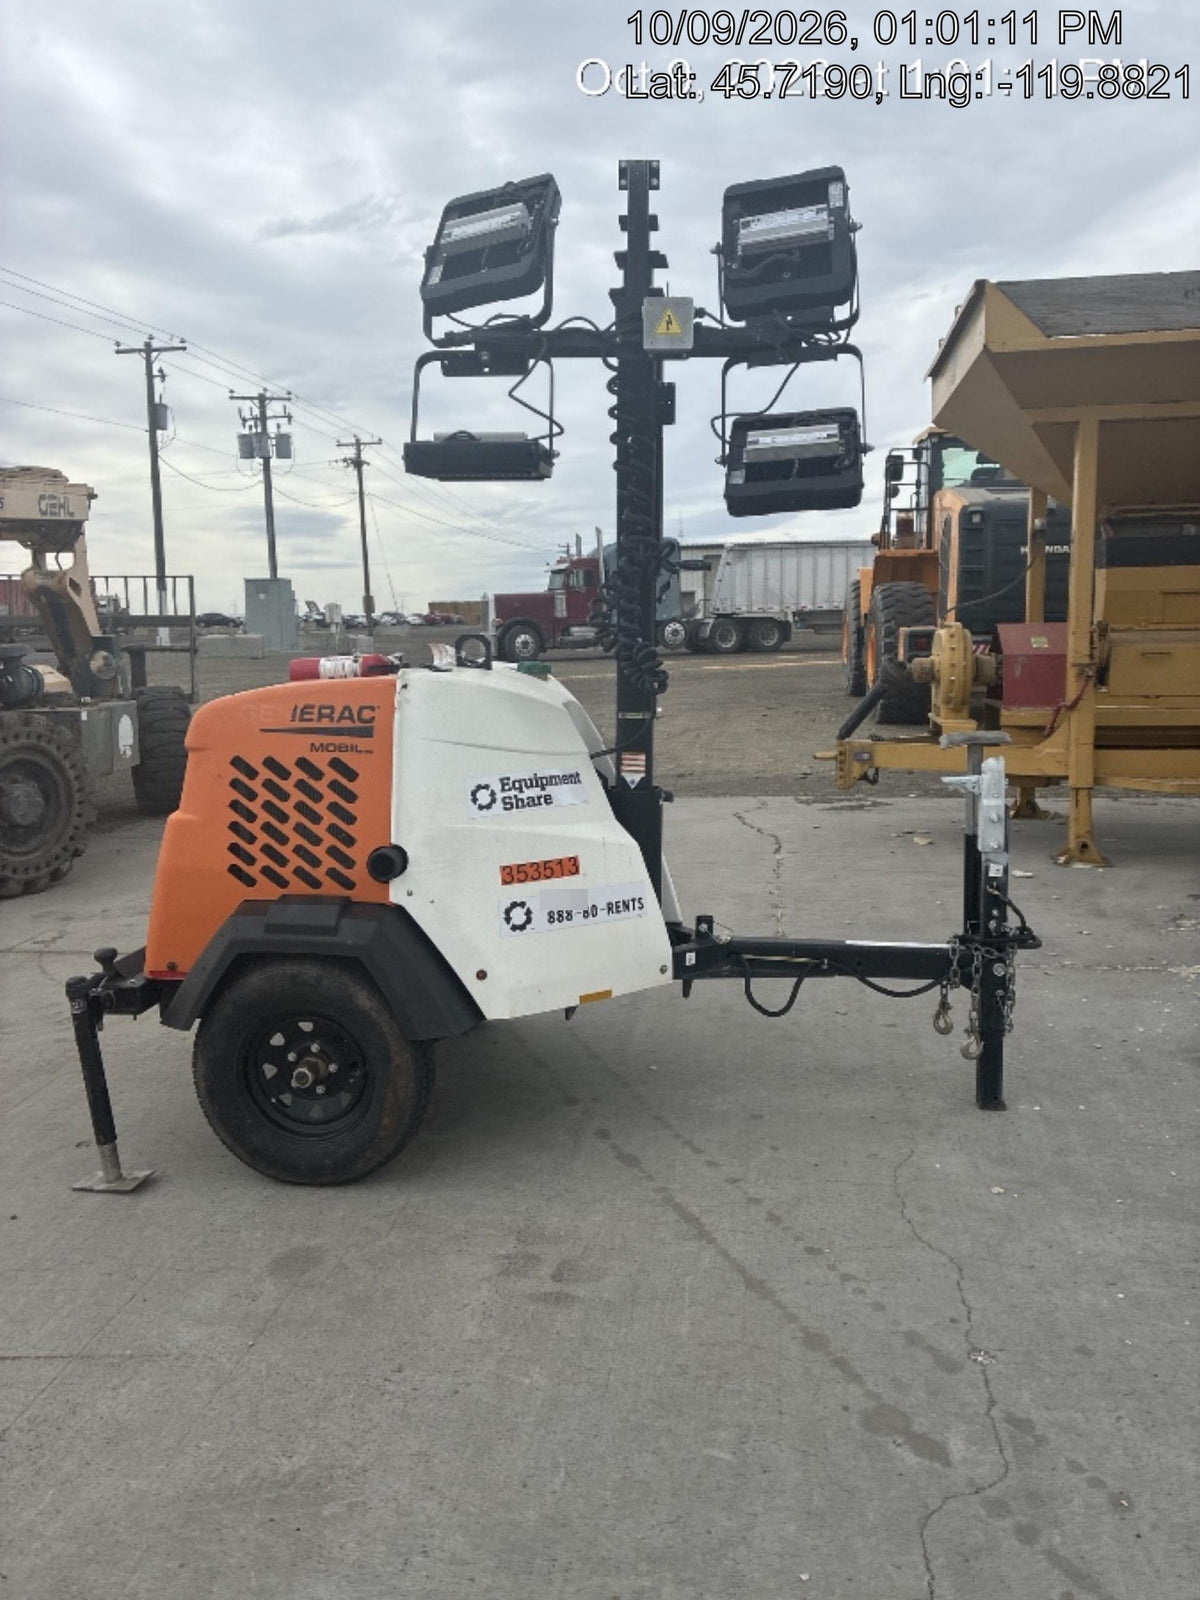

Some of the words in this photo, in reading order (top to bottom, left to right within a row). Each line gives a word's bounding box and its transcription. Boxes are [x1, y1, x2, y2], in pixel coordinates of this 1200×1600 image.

[499, 771, 582, 793] Equipment
[501, 792, 553, 812] Share
[501, 856, 580, 885] 353513
